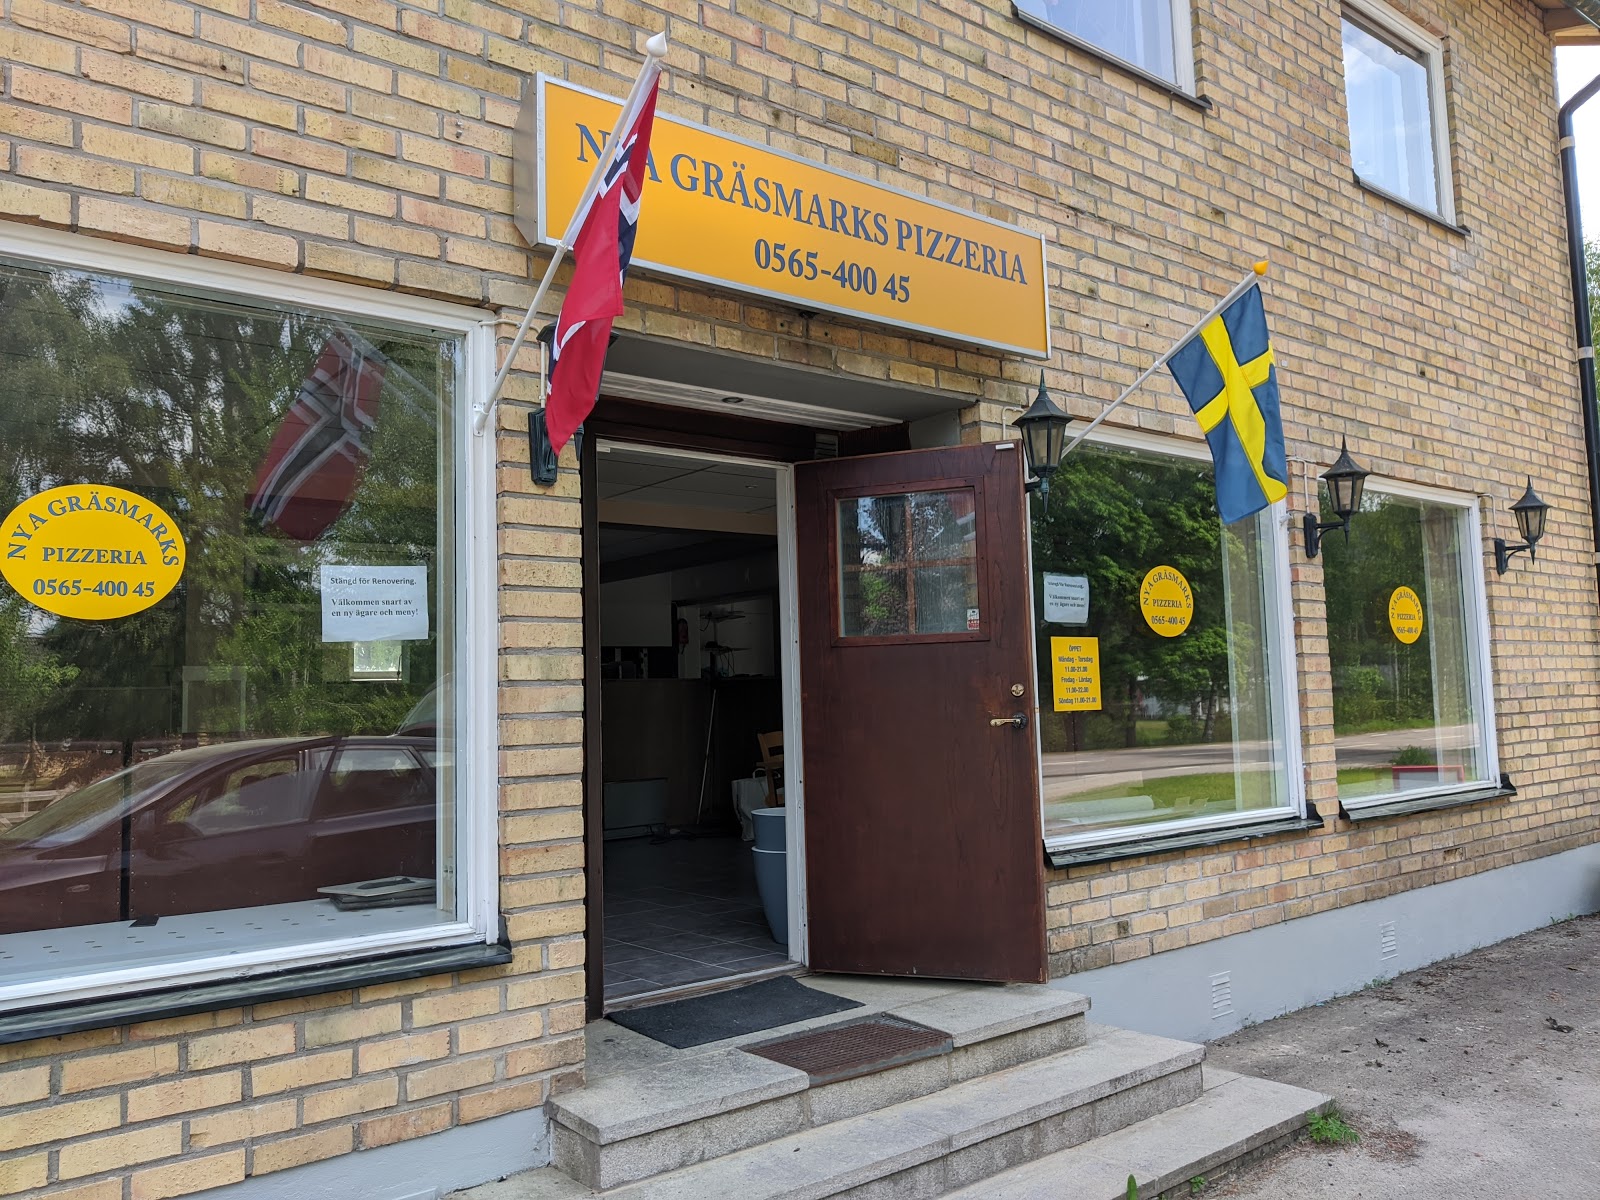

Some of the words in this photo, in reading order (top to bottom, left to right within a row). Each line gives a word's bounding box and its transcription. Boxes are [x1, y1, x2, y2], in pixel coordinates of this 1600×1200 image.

[670, 153, 889, 247] GRÄSMARKS
[896, 218, 1028, 285] PIZZERIA
[754, 238, 877, 297] 0565-400
[883, 272, 911, 304] 45
[7, 512, 48, 560] NYA
[47, 491, 180, 566] GRÄSMARKS
[42, 547, 148, 565] PIZZERIA
[33, 578, 128, 597] 0565-400
[132, 581, 155, 598] 45
[330, 577, 357, 586] Stängd
[359, 577, 370, 585] för
[372, 577, 417, 586] Renovering.
[1152, 569, 1192, 609] GRÄSMARKS
[331, 598, 380, 606] Välkommen
[382, 598, 402, 606] snart
[1152, 598, 1182, 608] PIZZERIA
[343, 610, 354, 618] ny
[355, 609, 378, 618] ägare
[380, 608, 393, 616] och
[1151, 615, 1178, 625] 0565-400
[1179, 616, 1186, 626] 45
